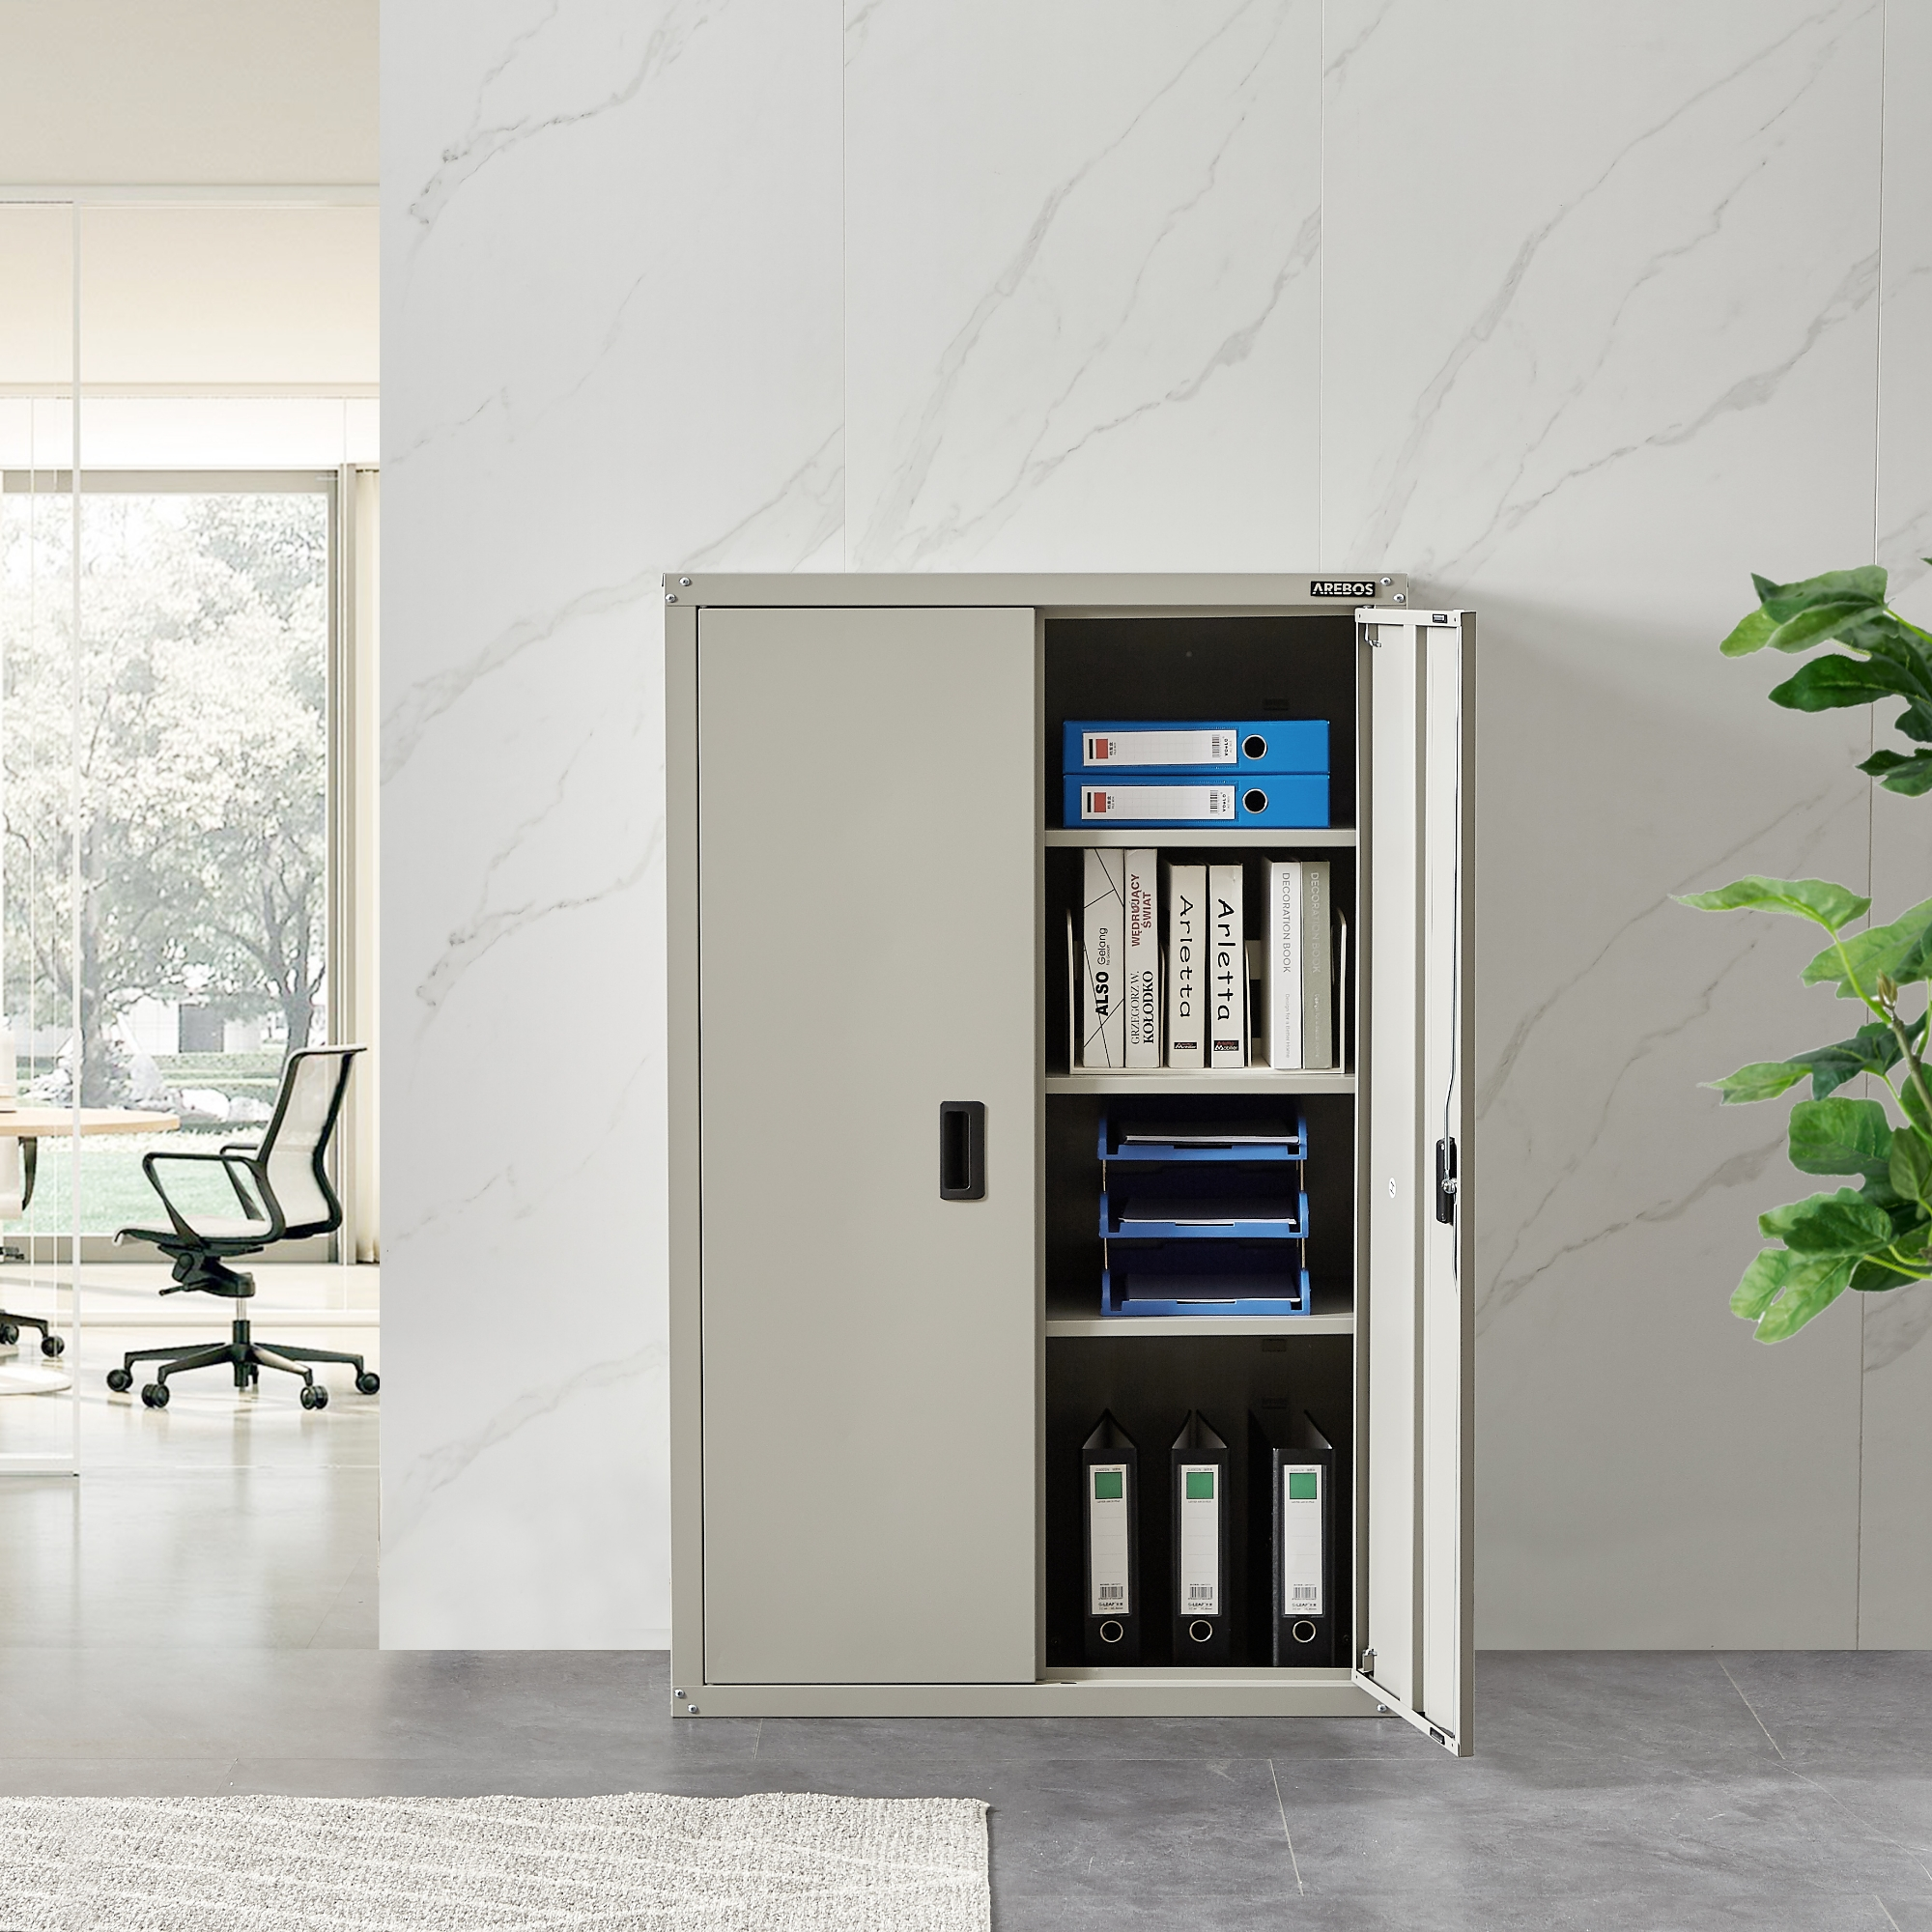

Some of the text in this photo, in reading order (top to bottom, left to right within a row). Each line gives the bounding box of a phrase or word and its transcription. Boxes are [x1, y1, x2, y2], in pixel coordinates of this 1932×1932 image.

[1312, 582, 1374, 595] AREBOS
[1143, 892, 1151, 928] ŚWIAT
[1282, 872, 1292, 973] DECORATION BOOK
[1311, 872, 1321, 973] DECORATION BOOK
[1095, 927, 1109, 1016] ALSO Gelang
[1179, 895, 1193, 1017] Arletta
[1217, 898, 1236, 1020] Arletta
[1131, 983, 1140, 1044] GRZEGORZ
[1143, 970, 1154, 1044] KOŁODKO
